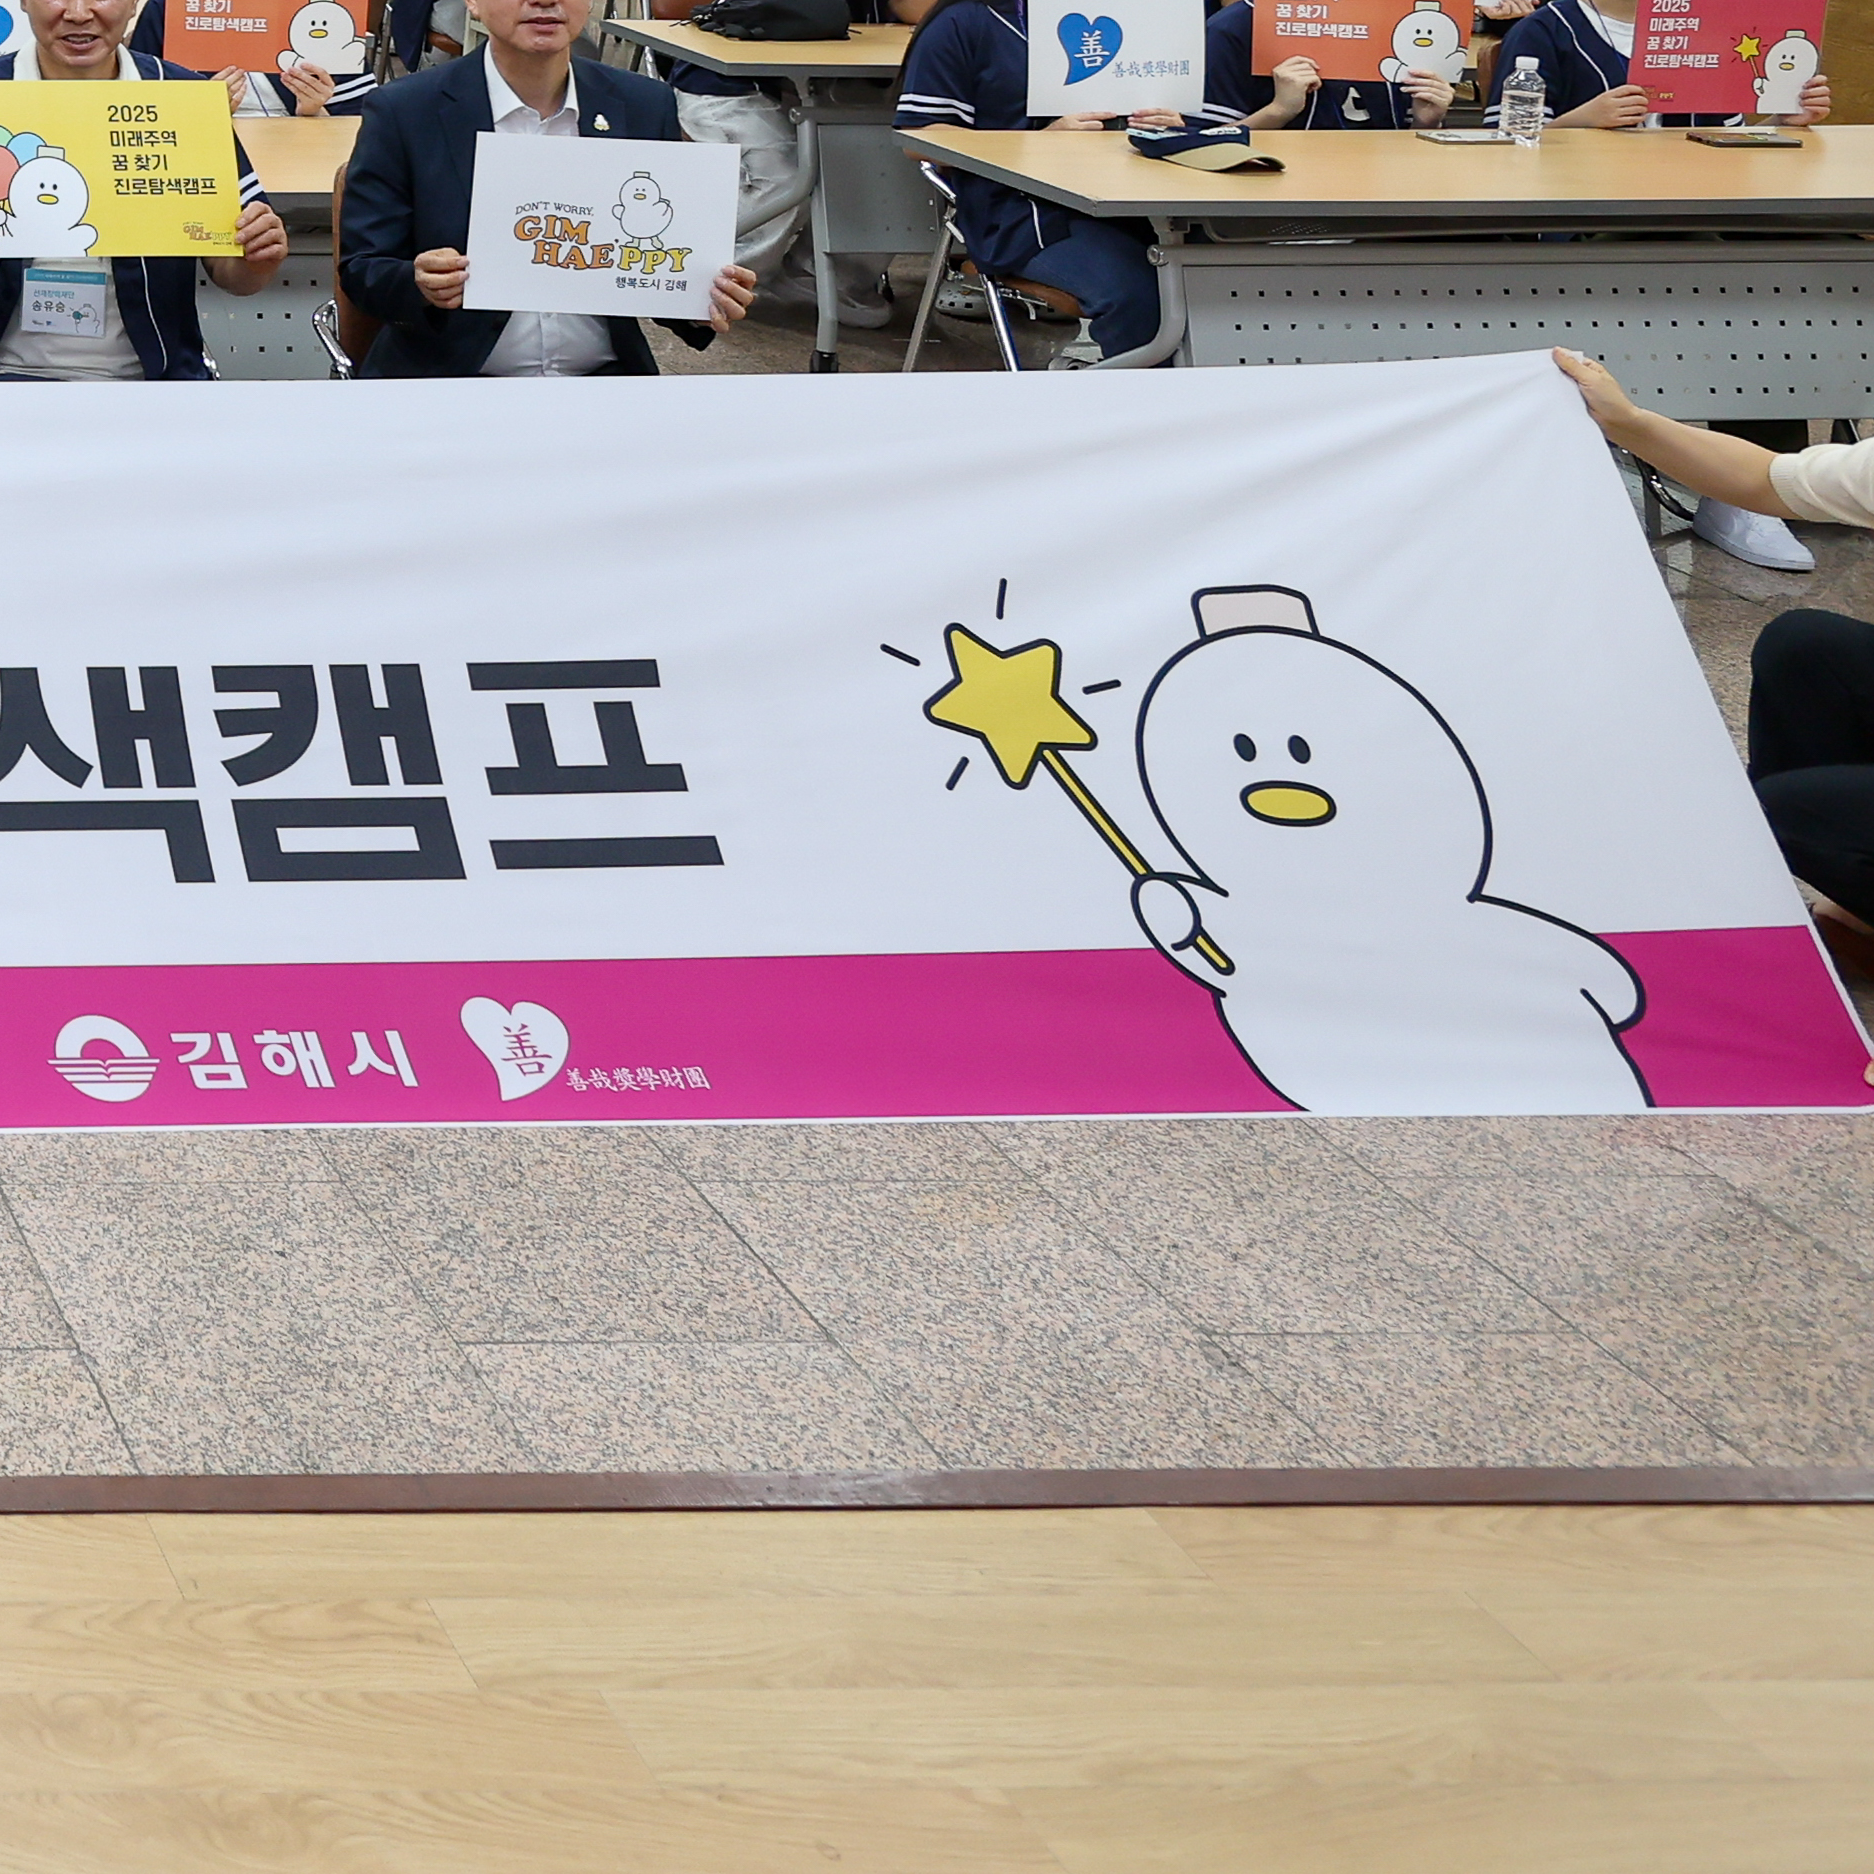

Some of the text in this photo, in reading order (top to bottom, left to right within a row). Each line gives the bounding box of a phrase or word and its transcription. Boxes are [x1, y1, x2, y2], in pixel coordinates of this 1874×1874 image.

[186, 0, 231, 13] 꿈 찾기
[1276, 3, 1327, 18] 꿈 찾기
[186, 16, 267, 32] 진로탐색캠프
[1276, 22, 1368, 39] 진로탐색캠프
[1650, 18, 1699, 31] 미래주역
[1075, 29, 1111, 68] 善
[1647, 36, 1688, 50] 꿈 찾기
[1645, 55, 1719, 68] 진로탐색캠프
[108, 105, 157, 122] 2025
[110, 131, 176, 147] 미래주역
[113, 155, 167, 171] 꿈 찾기
[115, 178, 217, 195] 진로탐색캠프
[515, 201, 550, 215] DON'T
[514, 215, 591, 245] GIM
[616, 277, 687, 291] 행복도시 김해
[501, 1023, 552, 1076] 善
[170, 1030, 418, 1089] 김해시
